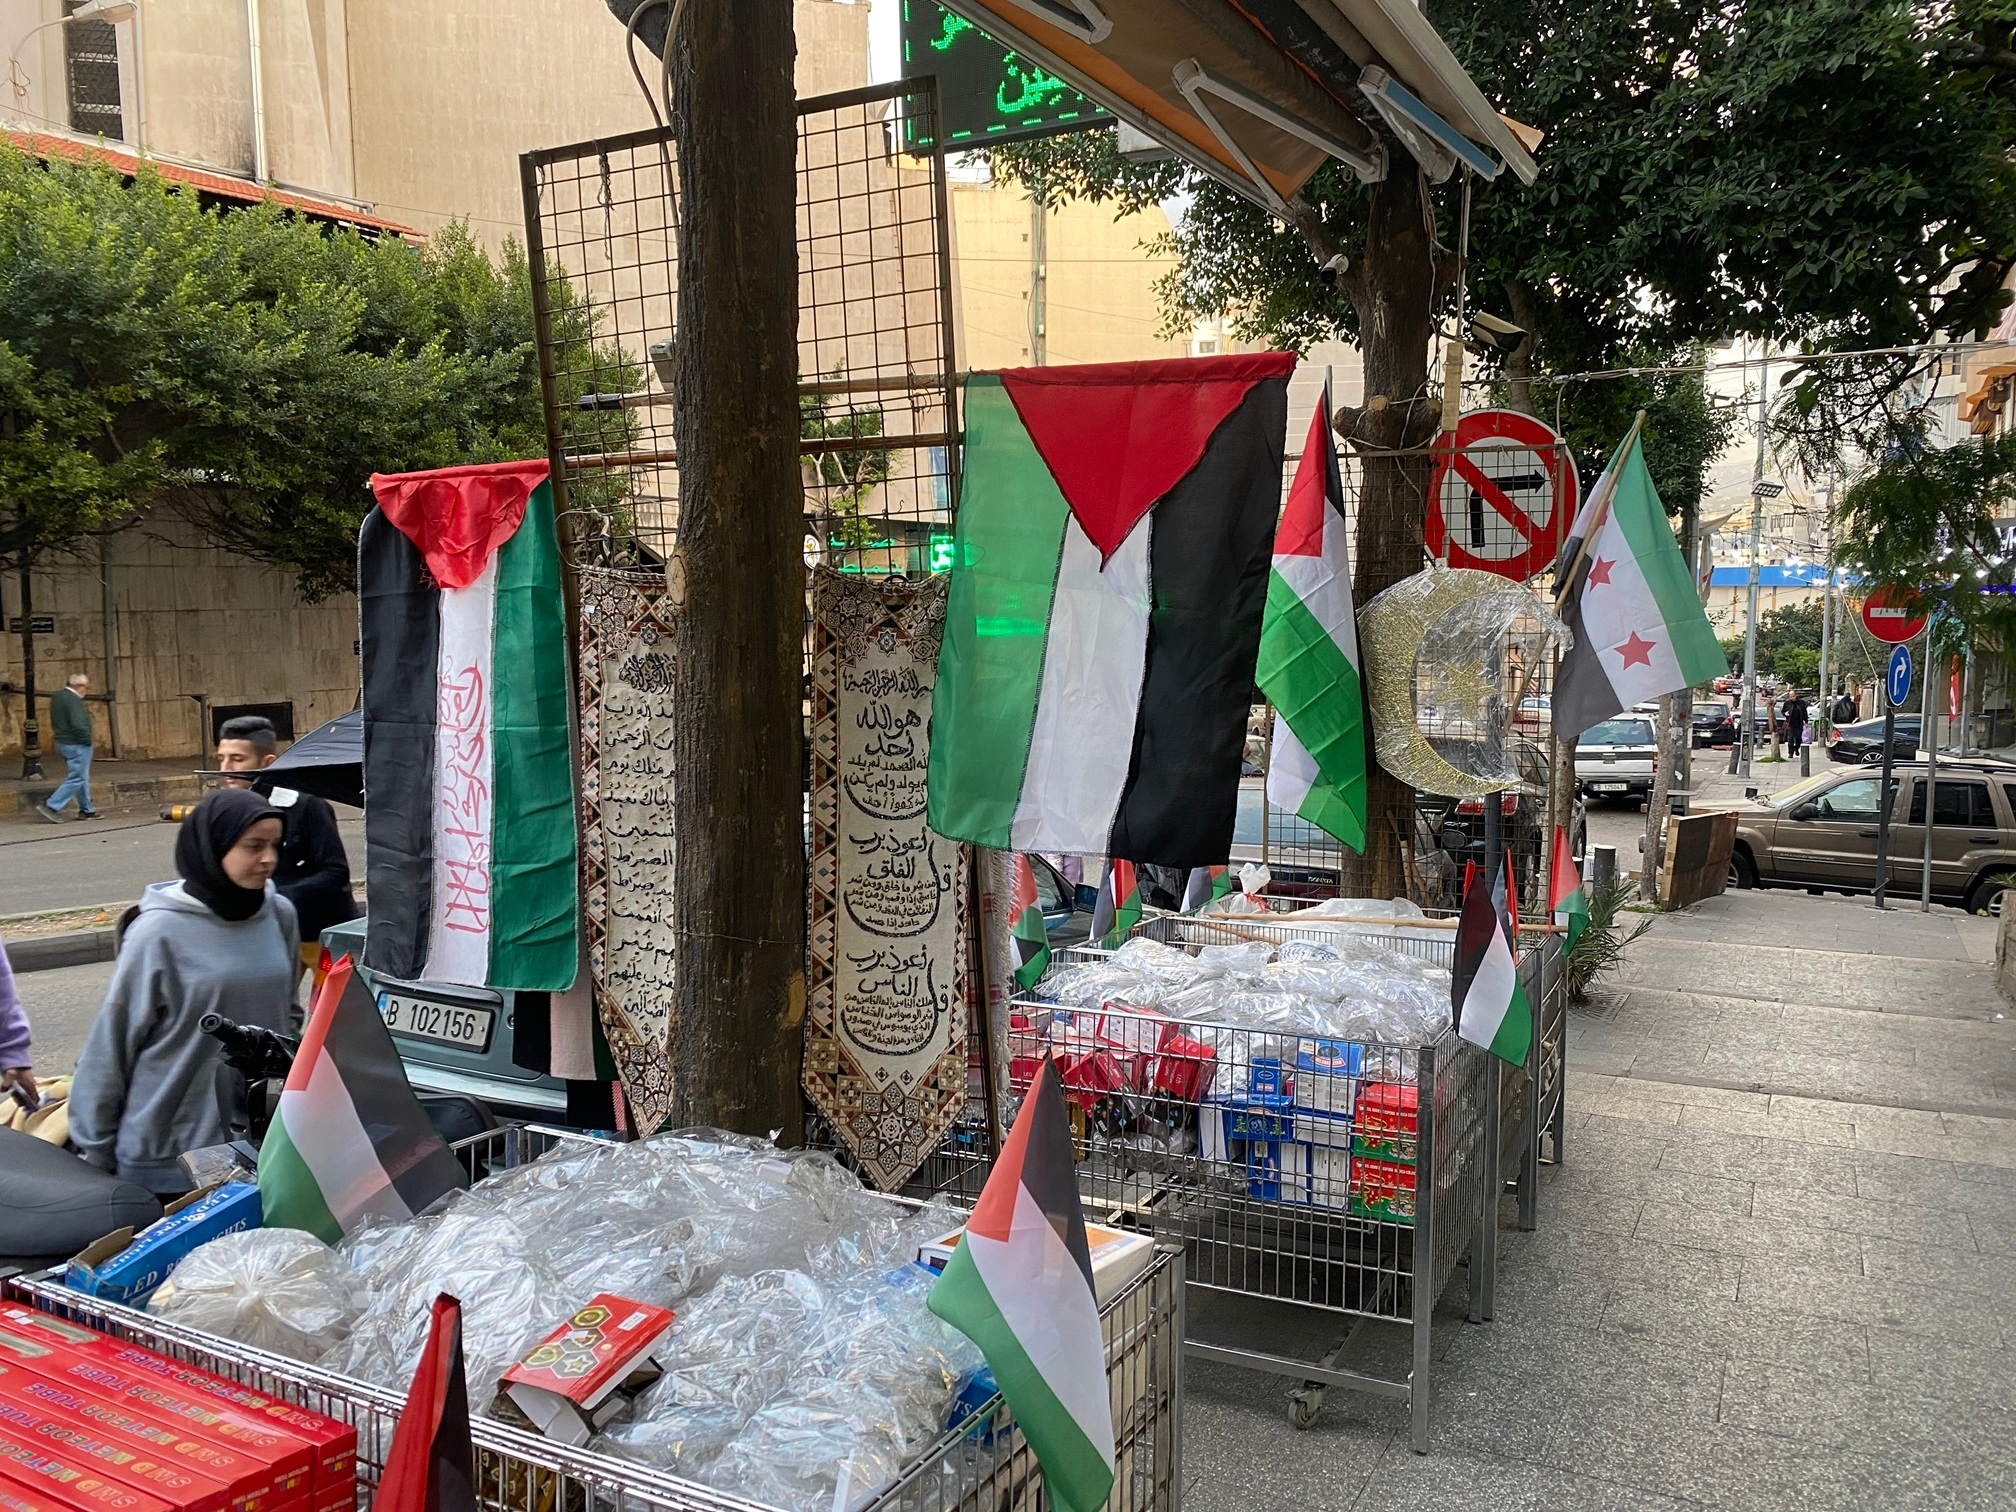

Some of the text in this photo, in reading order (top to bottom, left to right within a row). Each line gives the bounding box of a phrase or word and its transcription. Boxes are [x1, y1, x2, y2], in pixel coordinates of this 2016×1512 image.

[857, 700, 892, 730] الله
[848, 826, 927, 857] أعوذ برب
[866, 856, 915, 880] الفلق
[846, 944, 928, 973] أعوذ برب
[858, 974, 918, 998] الناس
[387, 1000, 476, 1041] B 102156
[122, 1270, 159, 1301] LED
[67, 1363, 130, 1391] TUBE
[115, 1349, 176, 1377] TUBE
[22, 1382, 86, 1409] TUBE
[172, 1369, 270, 1410] METEOR
[0, 1403, 42, 1428] TUB
[126, 1384, 223, 1427] METEOR
[80, 1403, 179, 1446] METEOR
[36, 1423, 136, 1466] METEOR
[0, 1439, 82, 1483] METEO
